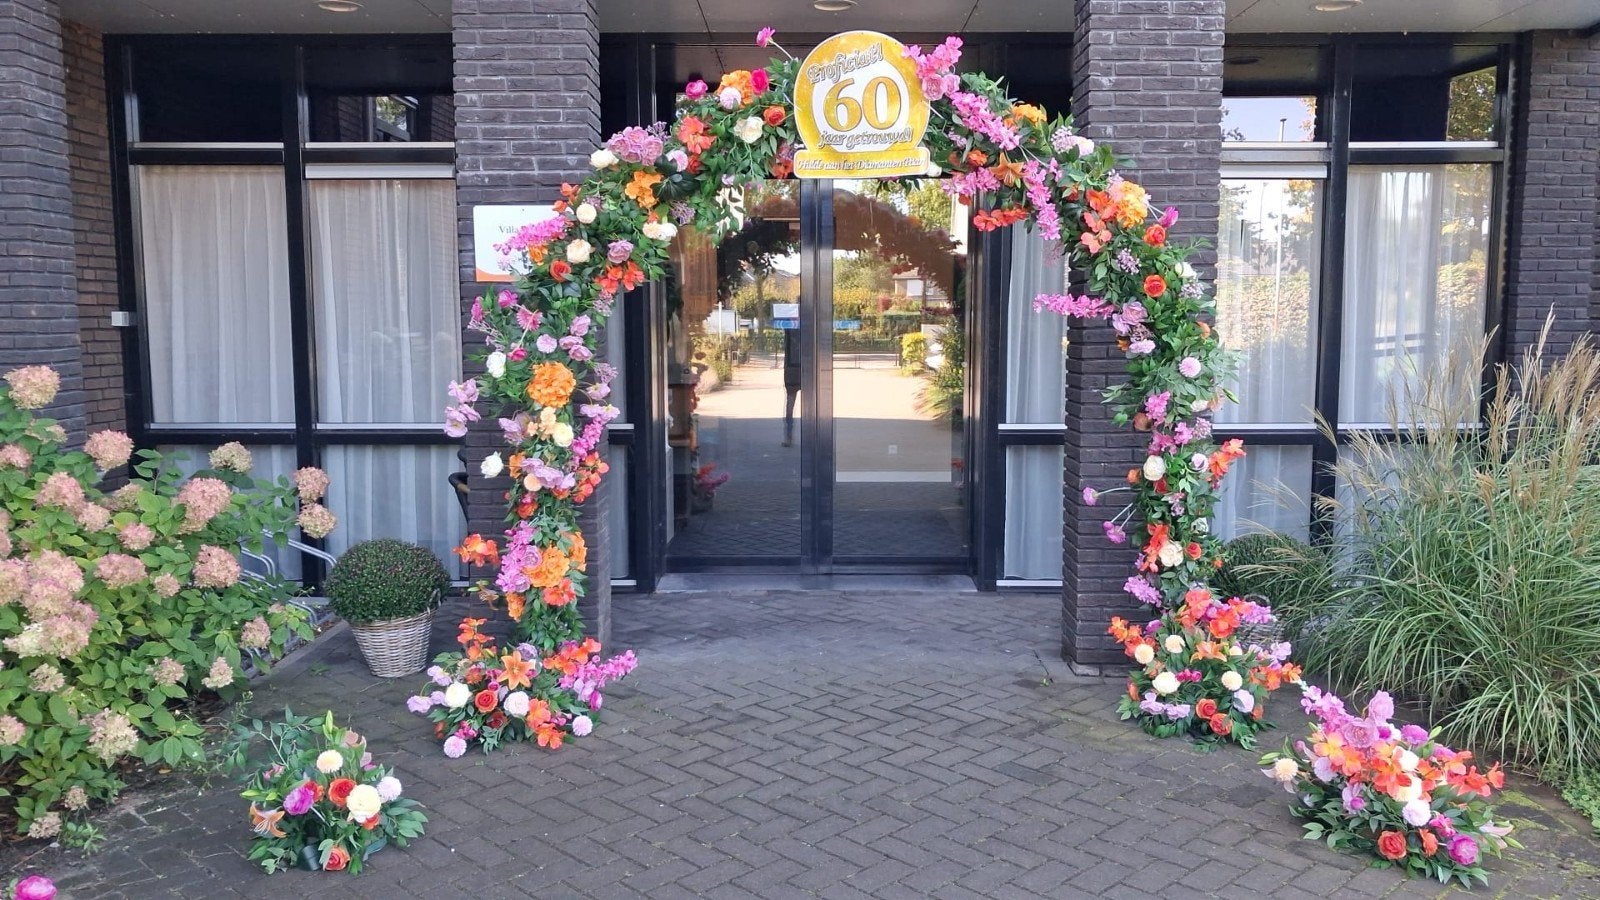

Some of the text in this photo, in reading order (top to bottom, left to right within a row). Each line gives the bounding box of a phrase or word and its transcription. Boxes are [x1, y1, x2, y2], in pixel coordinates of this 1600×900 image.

[807, 43, 883, 85] Proficiat!
[823, 76, 902, 132] 60
[818, 127, 914, 150] jaar getrouwd!
[498, 225, 520, 234] Villa
